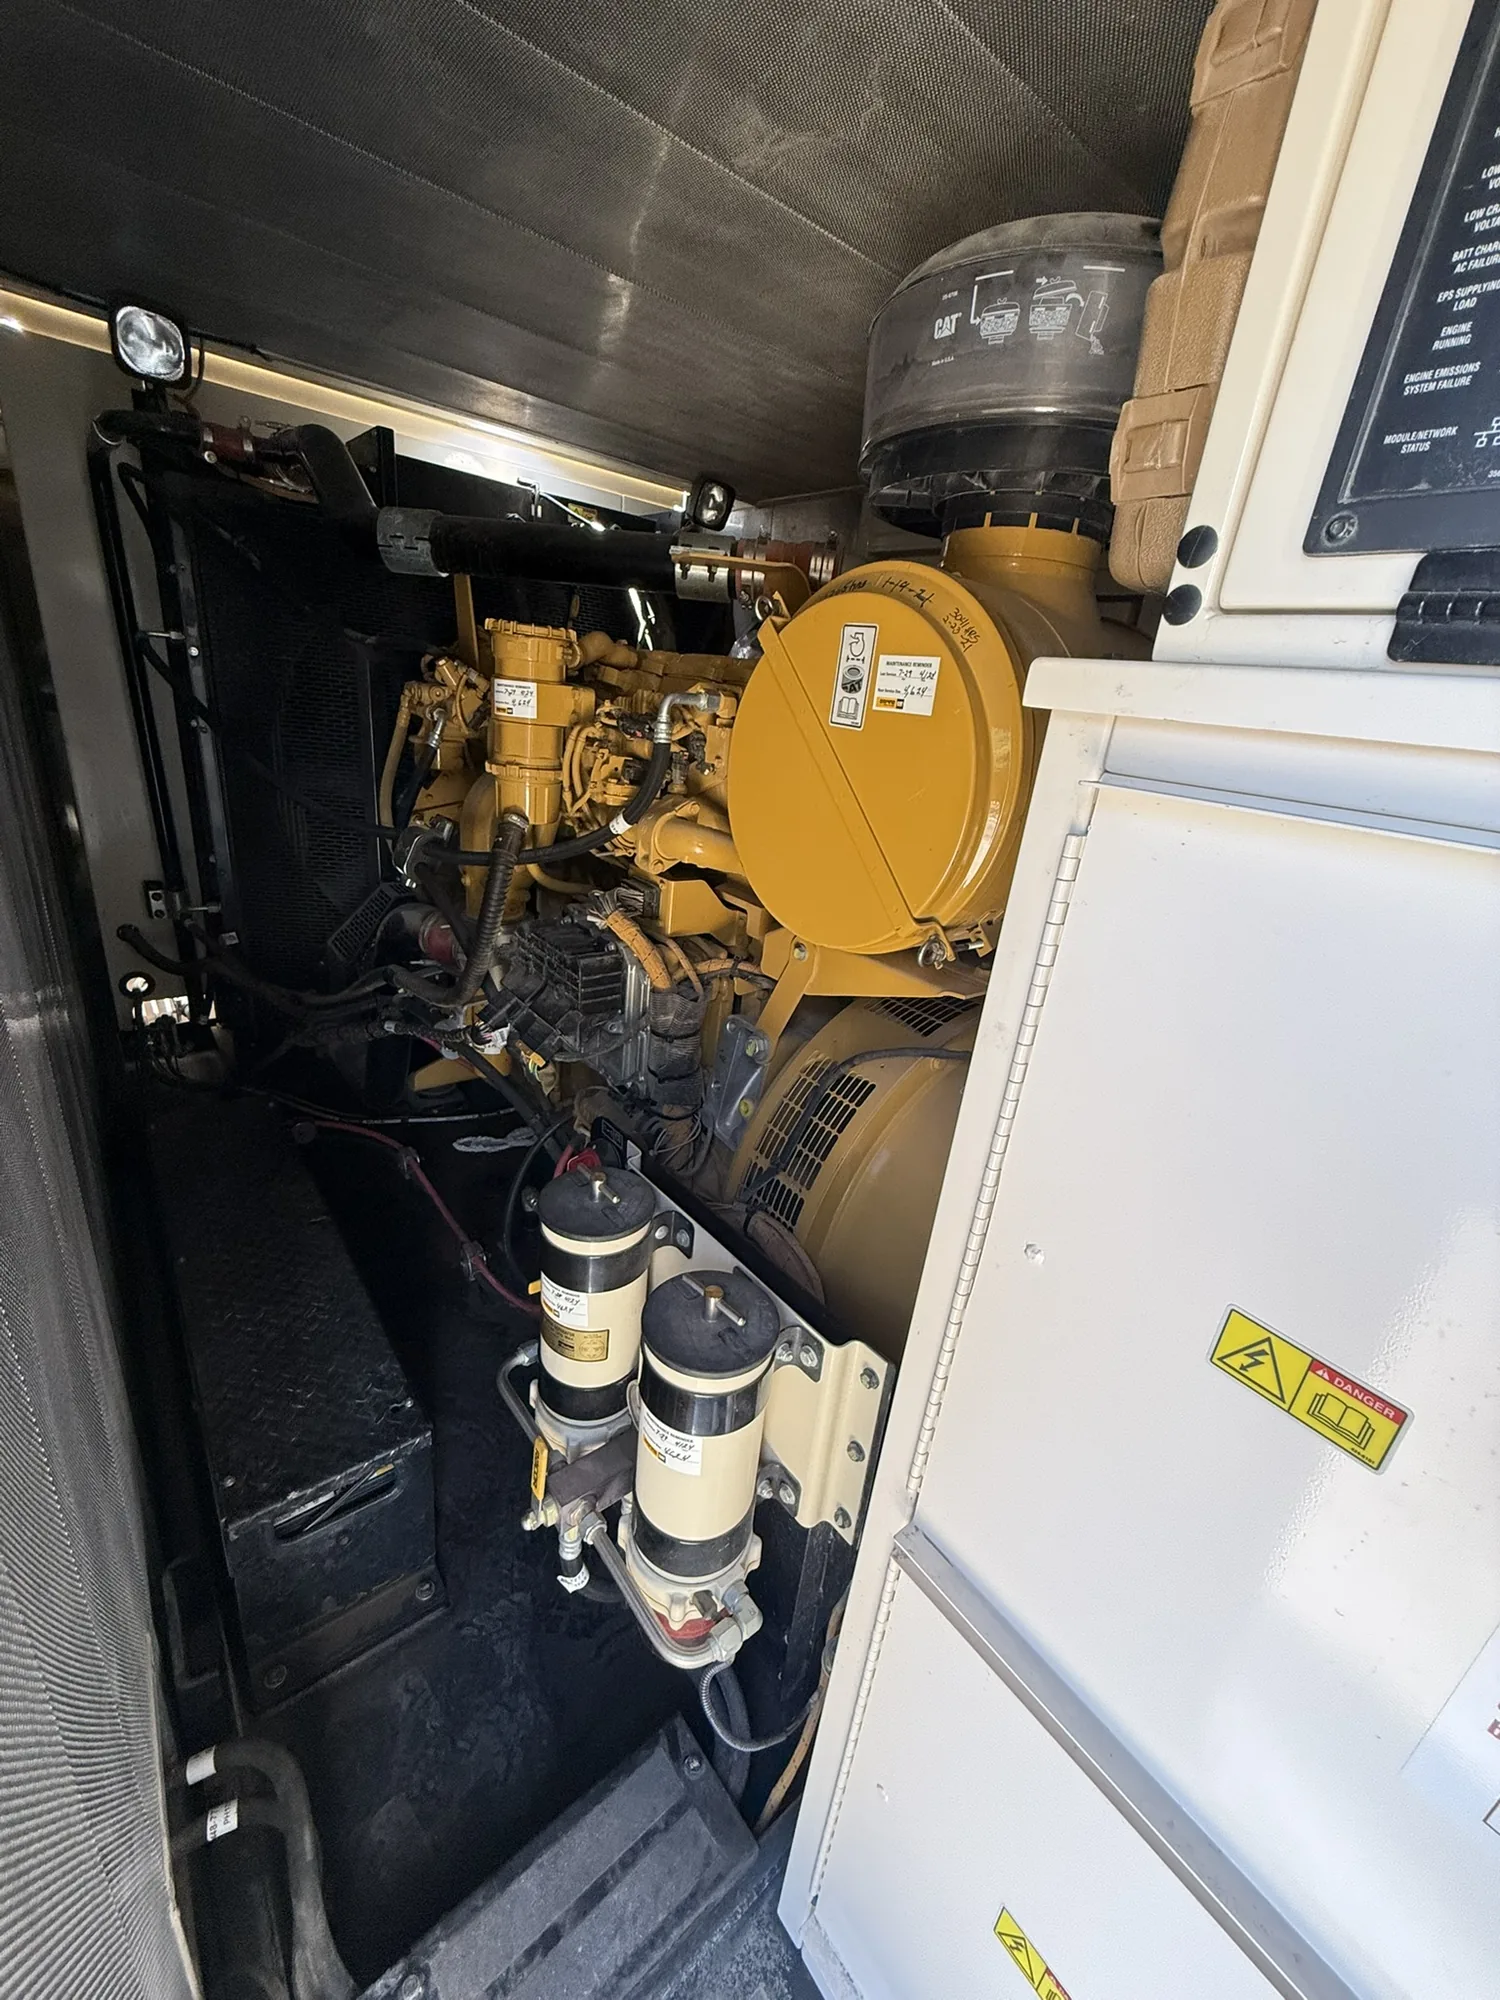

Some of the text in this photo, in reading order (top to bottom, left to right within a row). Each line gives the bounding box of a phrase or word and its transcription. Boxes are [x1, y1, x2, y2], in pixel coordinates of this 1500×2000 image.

[1464, 207, 1486, 223] LOW
[1451, 240, 1500, 263] BATT CHAR
[1453, 261, 1468, 274] AC
[1437, 289, 1455, 304] EPS
[1452, 297, 1477, 312] LOAD
[934, 312, 960, 339] CAT
[1440, 321, 1473, 337] ENGINE
[1432, 334, 1472, 351] RUNNING
[1403, 361, 1481, 384] ENGINE EMISSIONS
[1403, 375, 1473, 396] SYSTEM FAILURE
[1383, 426, 1459, 445] MODULE/NETWORK
[1400, 441, 1431, 454] STATUS
[1333, 1376, 1396, 1419] DANGER
